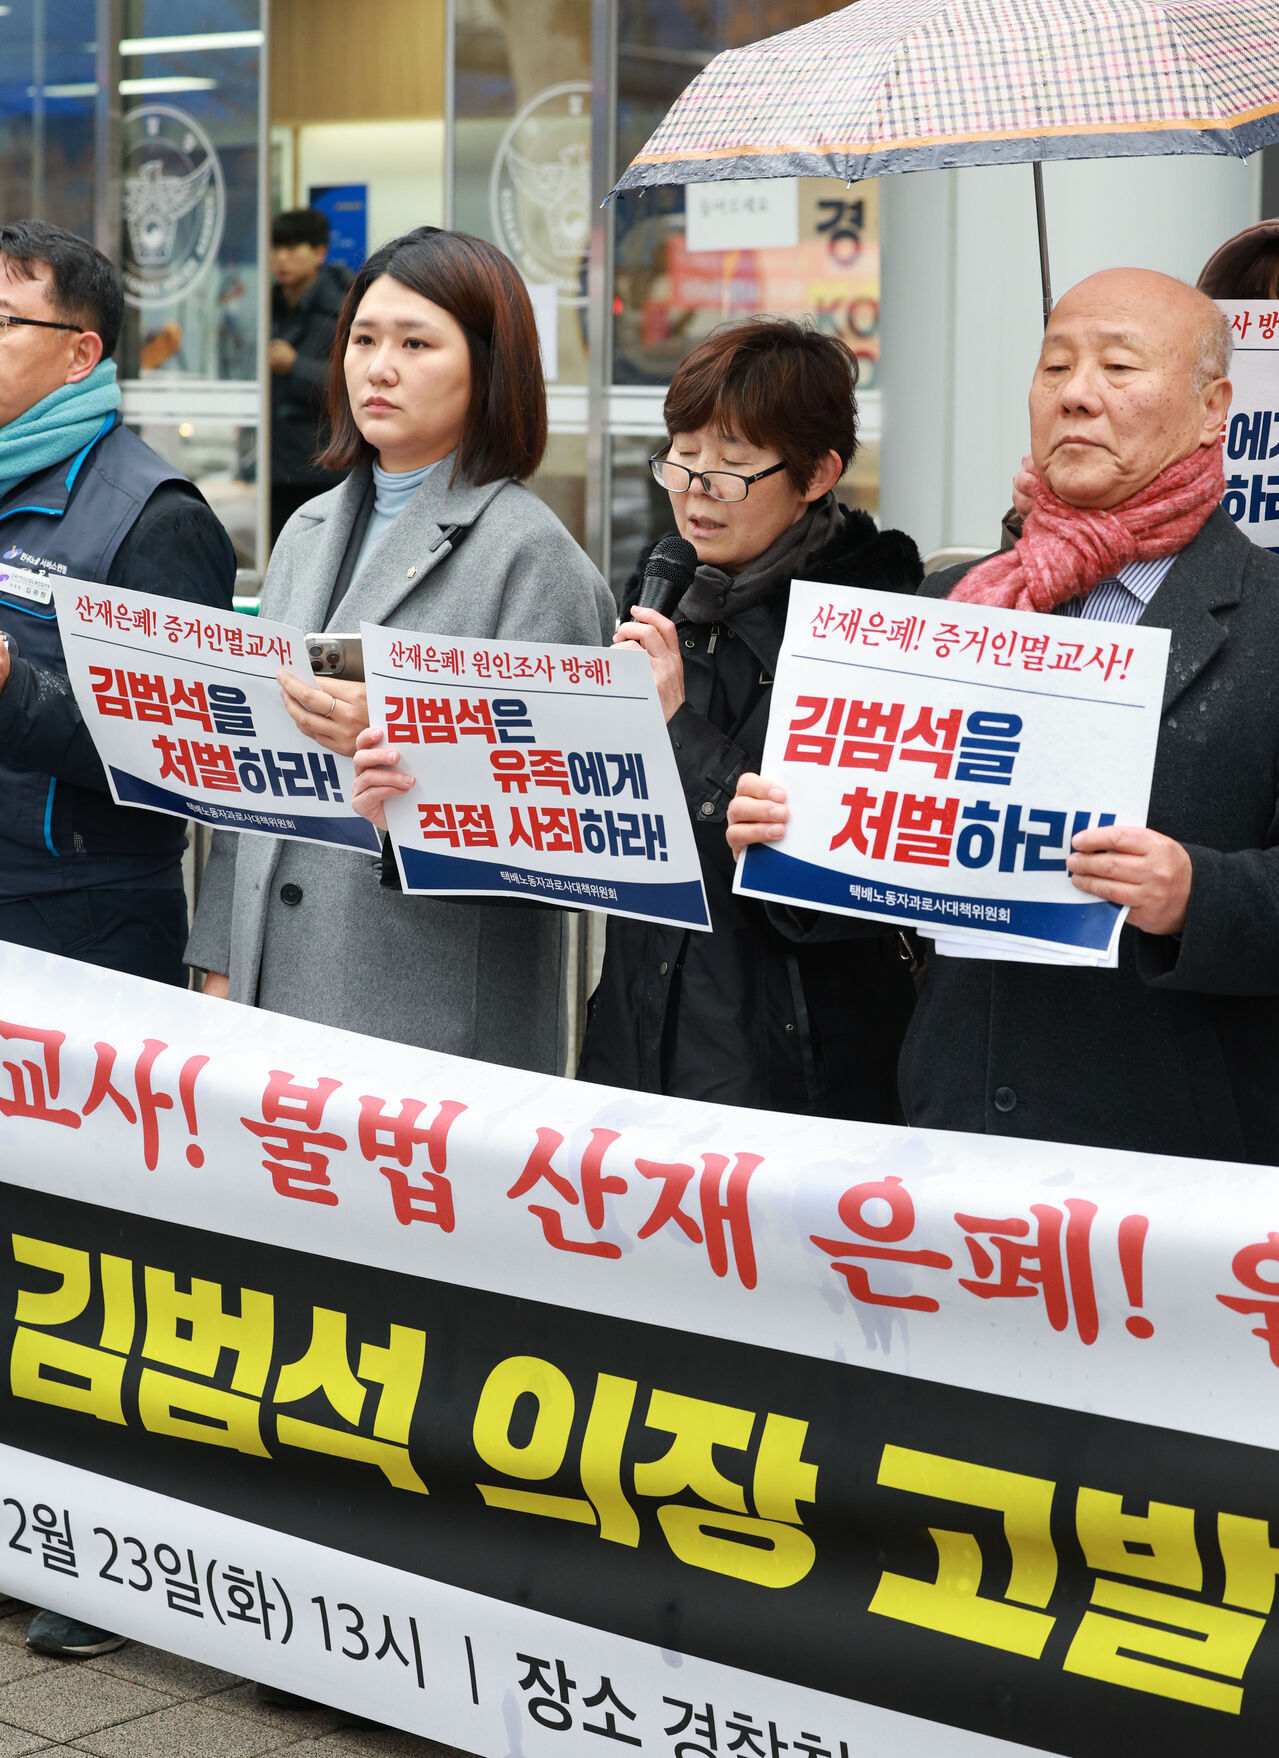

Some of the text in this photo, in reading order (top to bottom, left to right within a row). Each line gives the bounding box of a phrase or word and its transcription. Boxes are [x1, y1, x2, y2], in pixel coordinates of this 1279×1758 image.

[75, 595, 294, 666] 산재은폐! 증거인멸교사!
[388, 640, 613, 687] 산재은폐! 원인조사 방해!
[809, 603, 1135, 683] 산재은폐! 증거인멸교사!
[88, 665, 257, 738] 김범석을
[384, 695, 537, 745] 김범석은
[152, 734, 345, 803] 처벌하라!
[489, 749, 650, 801] 유족에게
[782, 694, 1024, 786] 김범석을
[185, 801, 297, 831] 택배노동자과로사대책위원회
[416, 802, 669, 863] 직접 사죄하라!
[829, 786, 1117, 878] 처벌하라
[499, 870, 619, 902] 택배노동자과로사대책위원회
[848, 883, 1012, 924] 택배노동자과로사대책위원회
[0, 1019, 211, 1172] 교사!
[240, 1069, 469, 1234] 불법
[506, 1126, 766, 1291] 산재
[809, 1175, 1156, 1346] 은폐!
[10, 1232, 1279, 1717] 김범석 의장 고발
[3, 1497, 80, 1579] 2월
[92, 1526, 295, 1645] 23일(화)
[311, 1595, 427, 1690] 13시
[515, 1651, 644, 1748] 장소
